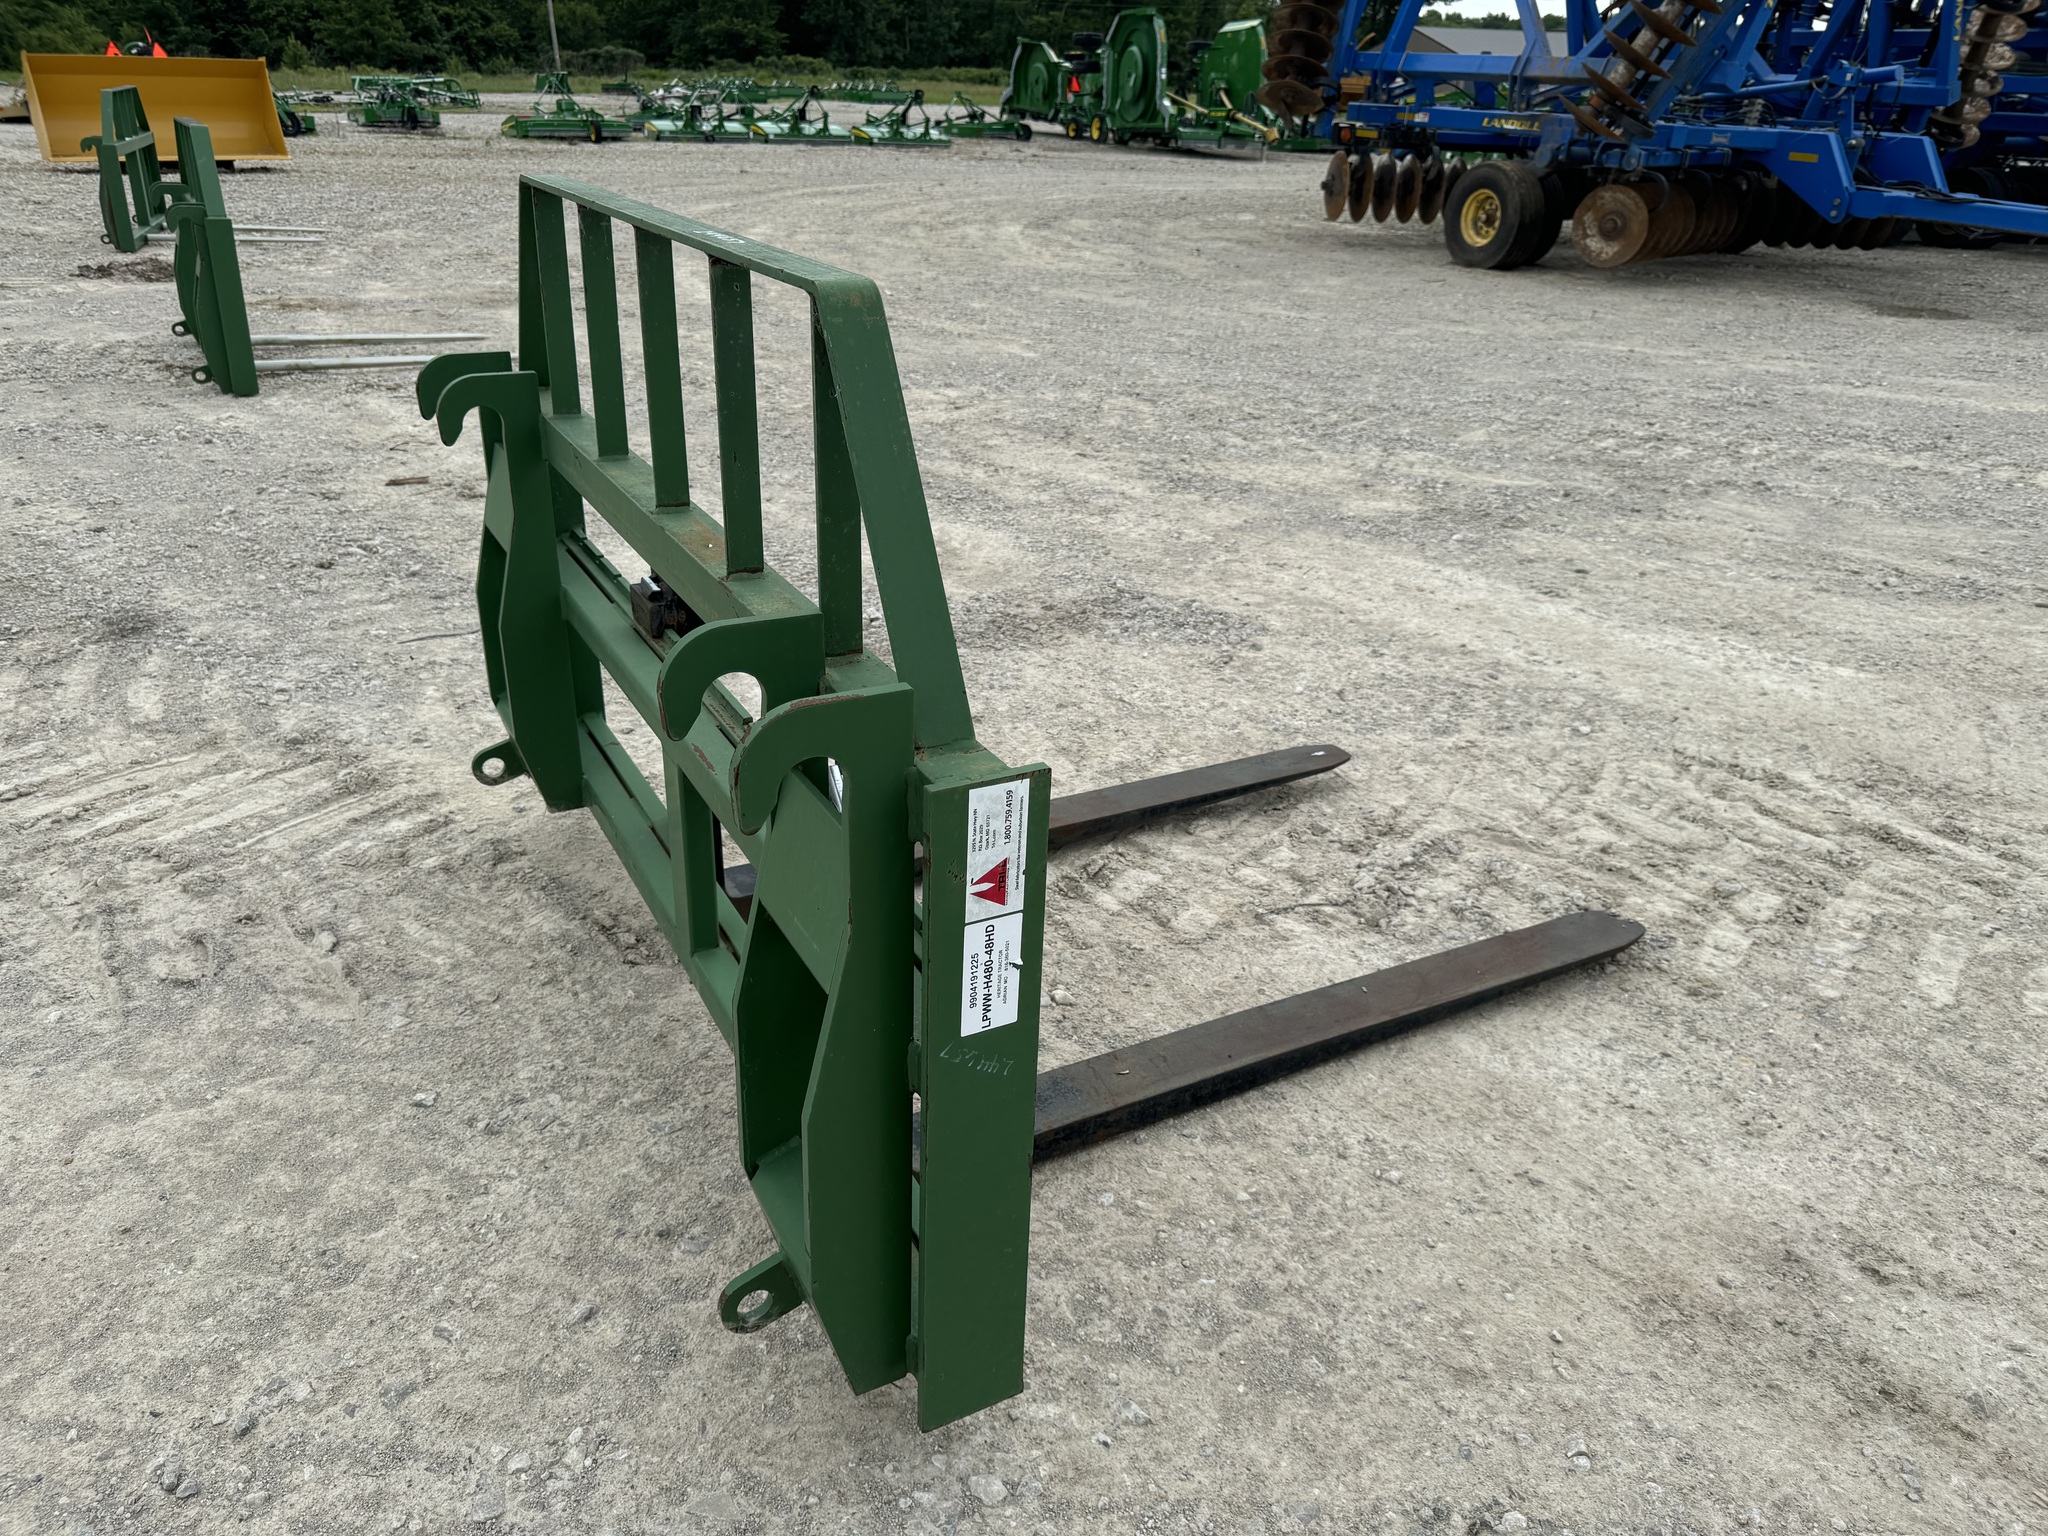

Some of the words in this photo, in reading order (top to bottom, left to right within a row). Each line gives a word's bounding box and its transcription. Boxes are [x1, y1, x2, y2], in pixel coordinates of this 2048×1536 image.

[1481, 116, 1541, 132] LANDOLL
[985, 828, 989, 836] MO
[1003, 788, 1013, 845] 1.800.759.4159
[968, 952, 979, 1009] 9904191225
[981, 923, 995, 1029] LPWW-H480-48HD
